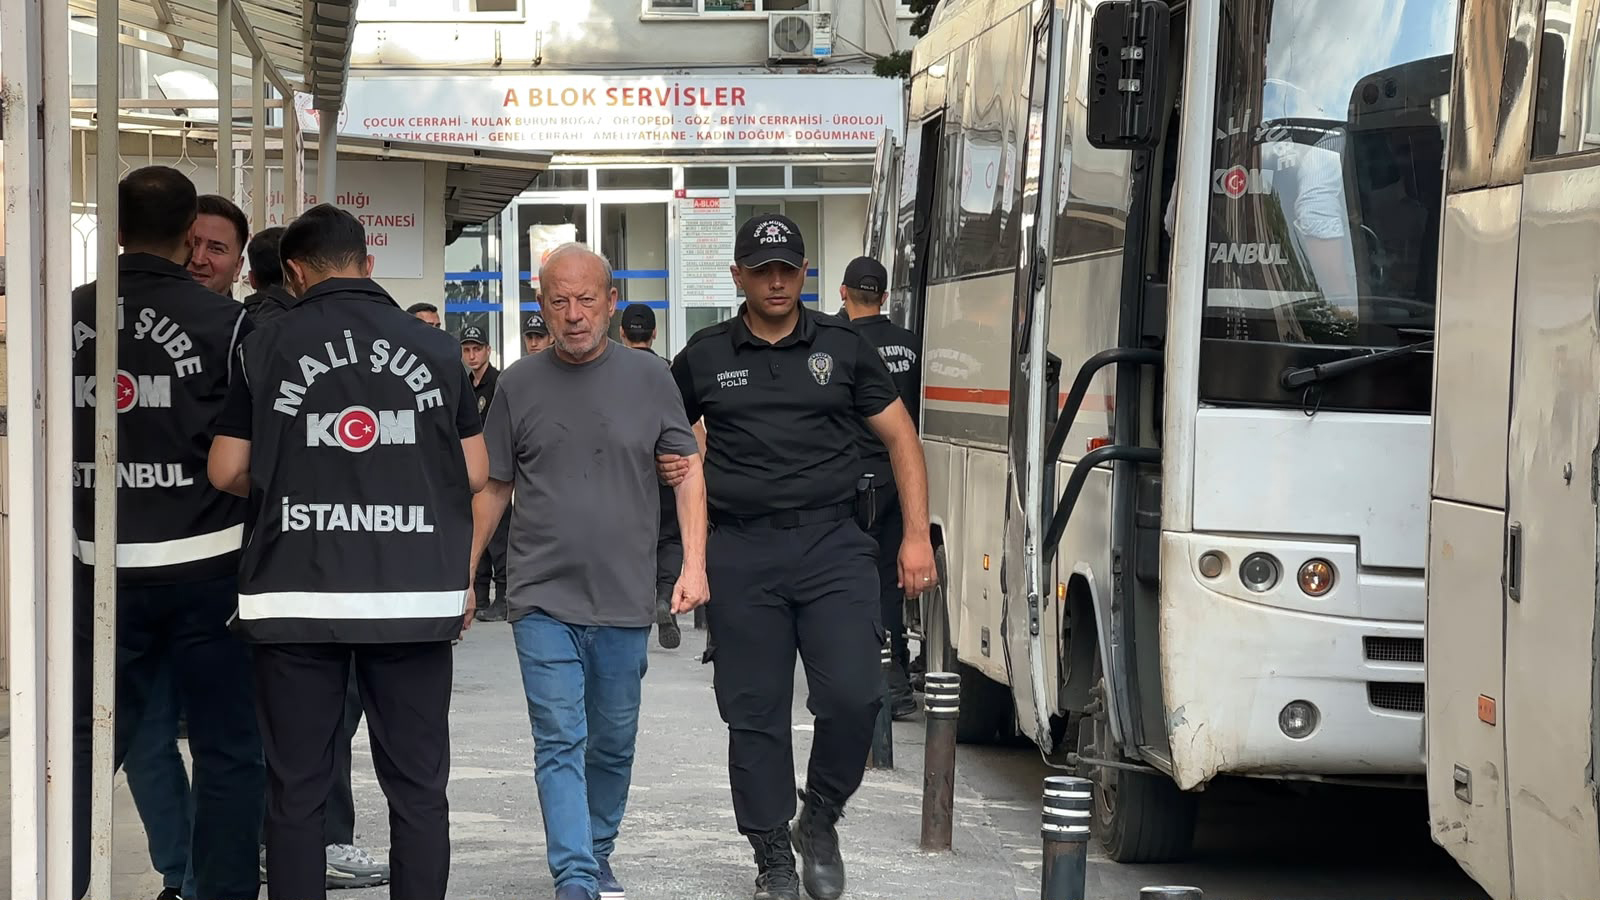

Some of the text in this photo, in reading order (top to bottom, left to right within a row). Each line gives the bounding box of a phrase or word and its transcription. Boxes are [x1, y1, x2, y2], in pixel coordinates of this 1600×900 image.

[503, 83, 747, 107] A BLOK SERVİSLER
[363, 117, 405, 129] ÇOCUK
[409, 115, 461, 127] CERRAHİ
[471, 116, 512, 127] KULAK
[685, 113, 711, 125] GÖZ
[720, 113, 756, 125] BEYİN
[759, 113, 822, 125] CERRAHİSİ
[832, 113, 884, 126] ÜROLOJİ
[425, 131, 478, 143] CERRAHİ
[488, 131, 525, 142] GENEL
[696, 130, 735, 141] KADIN
[738, 128, 785, 141] DOĞUM
[795, 128, 876, 141] DOĞUMHANE
[358, 213, 415, 227] STANESİ
[760, 234, 788, 245] POLİS
[1208, 242, 1289, 265] TANBUL
[134, 307, 203, 378] ŞUBE
[273, 329, 444, 417] MALİ ŞUBE
[720, 378, 748, 388] POLİS
[306, 405, 416, 453] KOM
[73, 461, 194, 489] STNBUL
[281, 496, 435, 533] İSTANBUL
